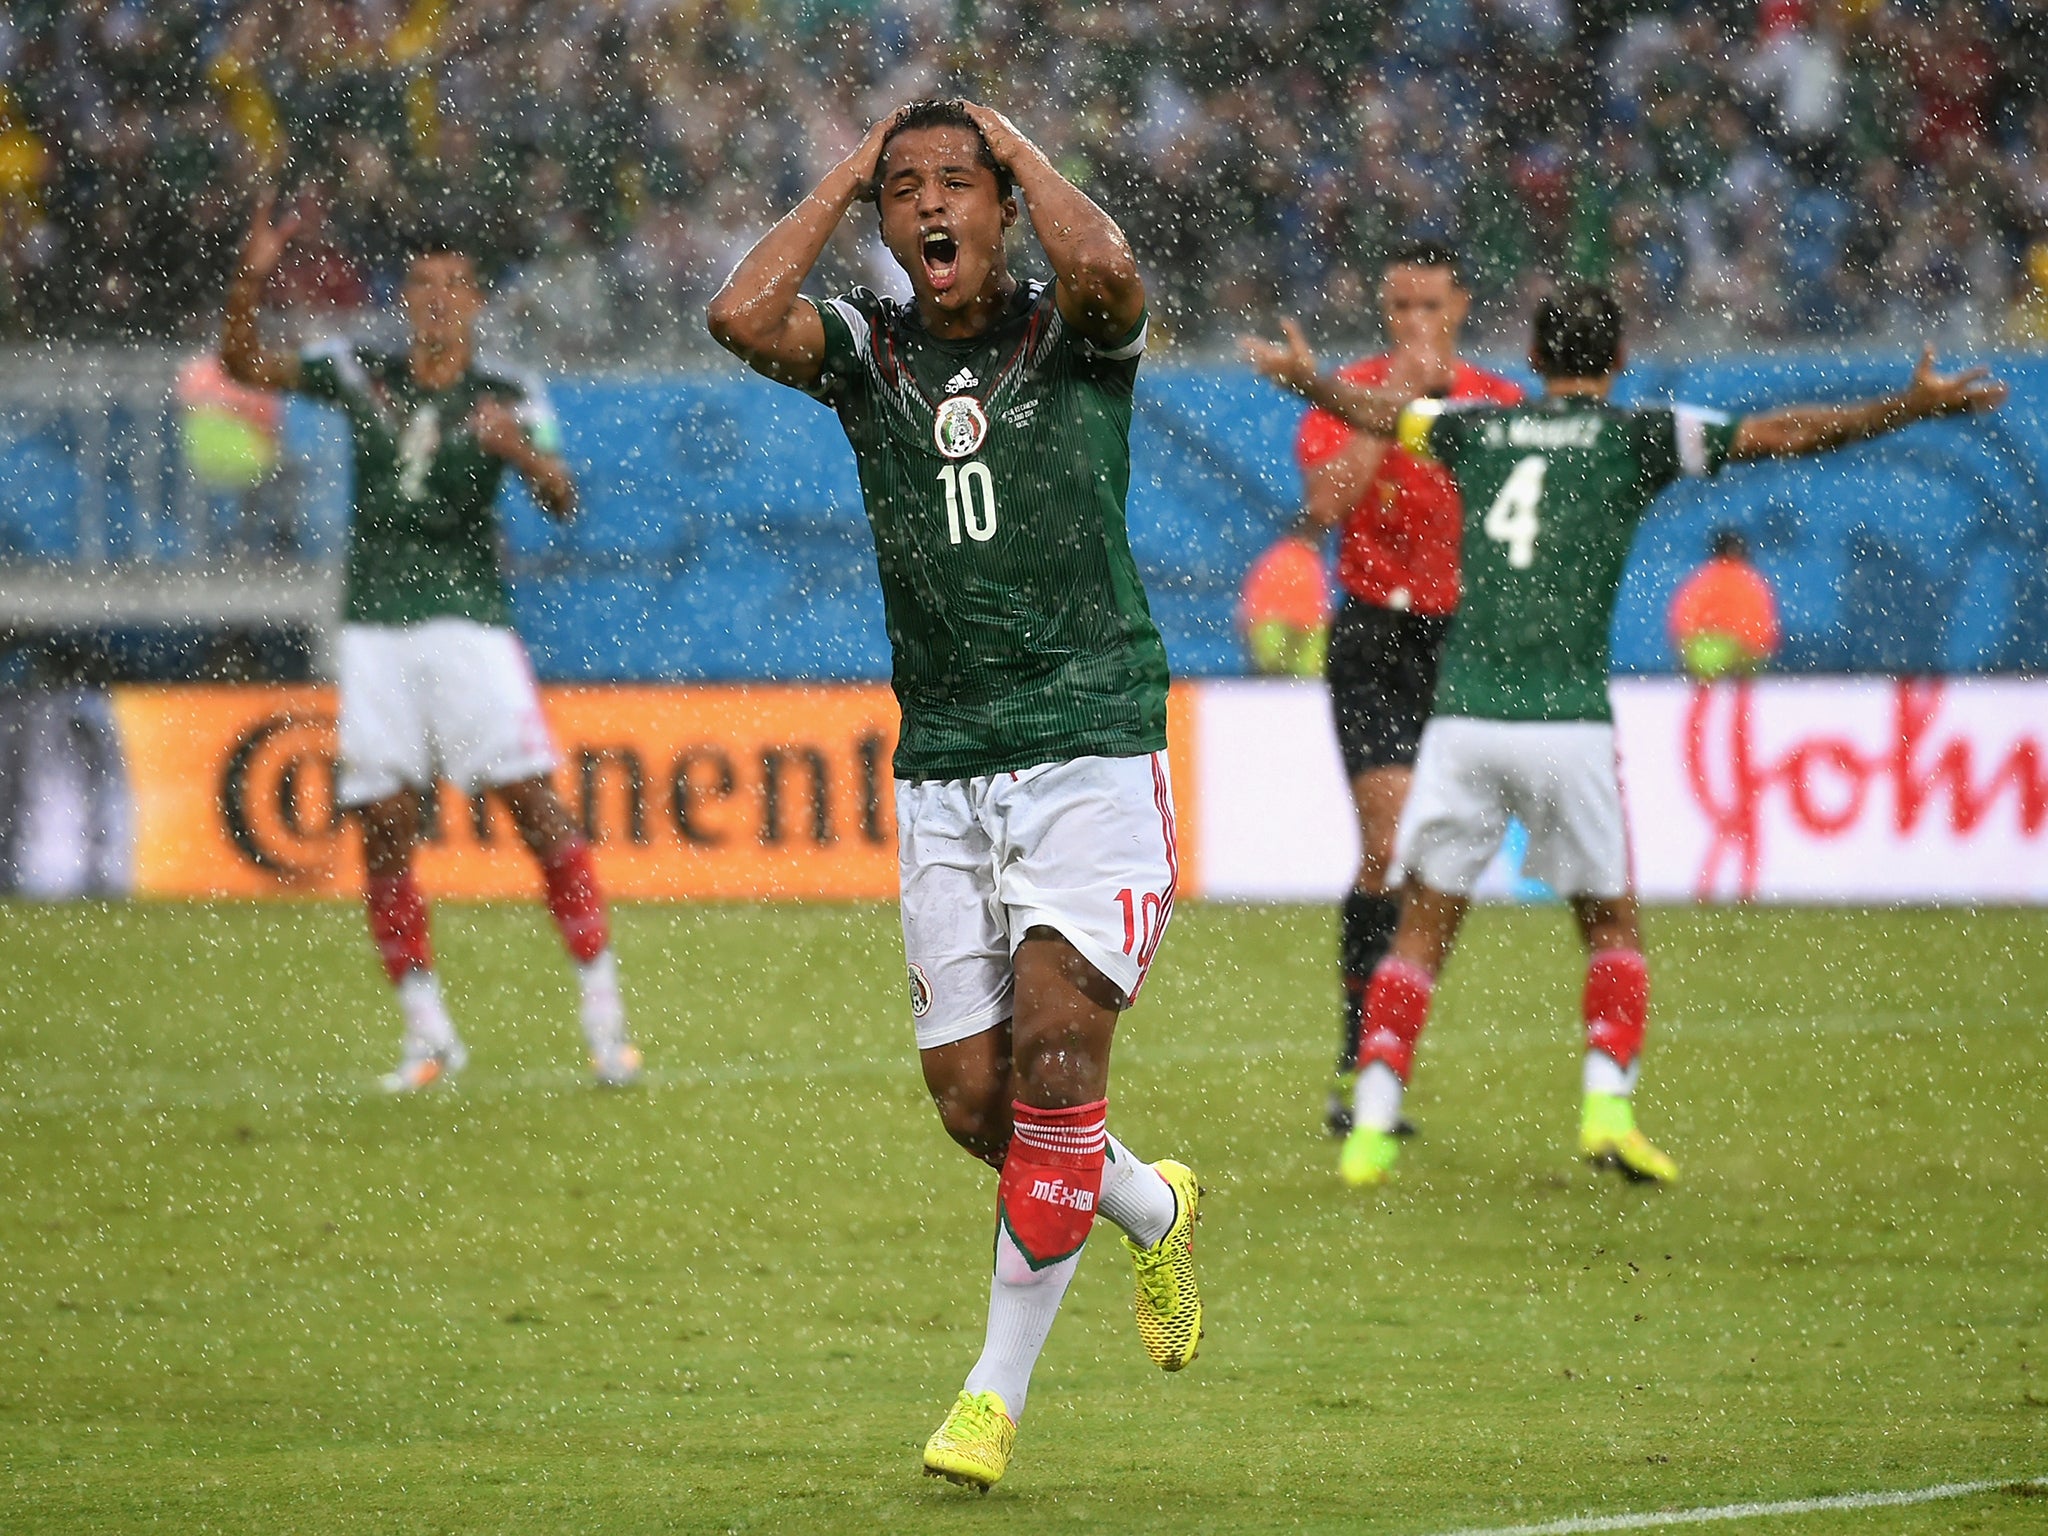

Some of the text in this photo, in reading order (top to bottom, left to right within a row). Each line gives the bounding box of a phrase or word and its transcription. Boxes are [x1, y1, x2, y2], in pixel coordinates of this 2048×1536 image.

[936, 461, 997, 545] 10
[1484, 455, 1547, 569] 4
[1113, 888, 1162, 968] 10
[1027, 1179, 1095, 1211] MÉXICO
